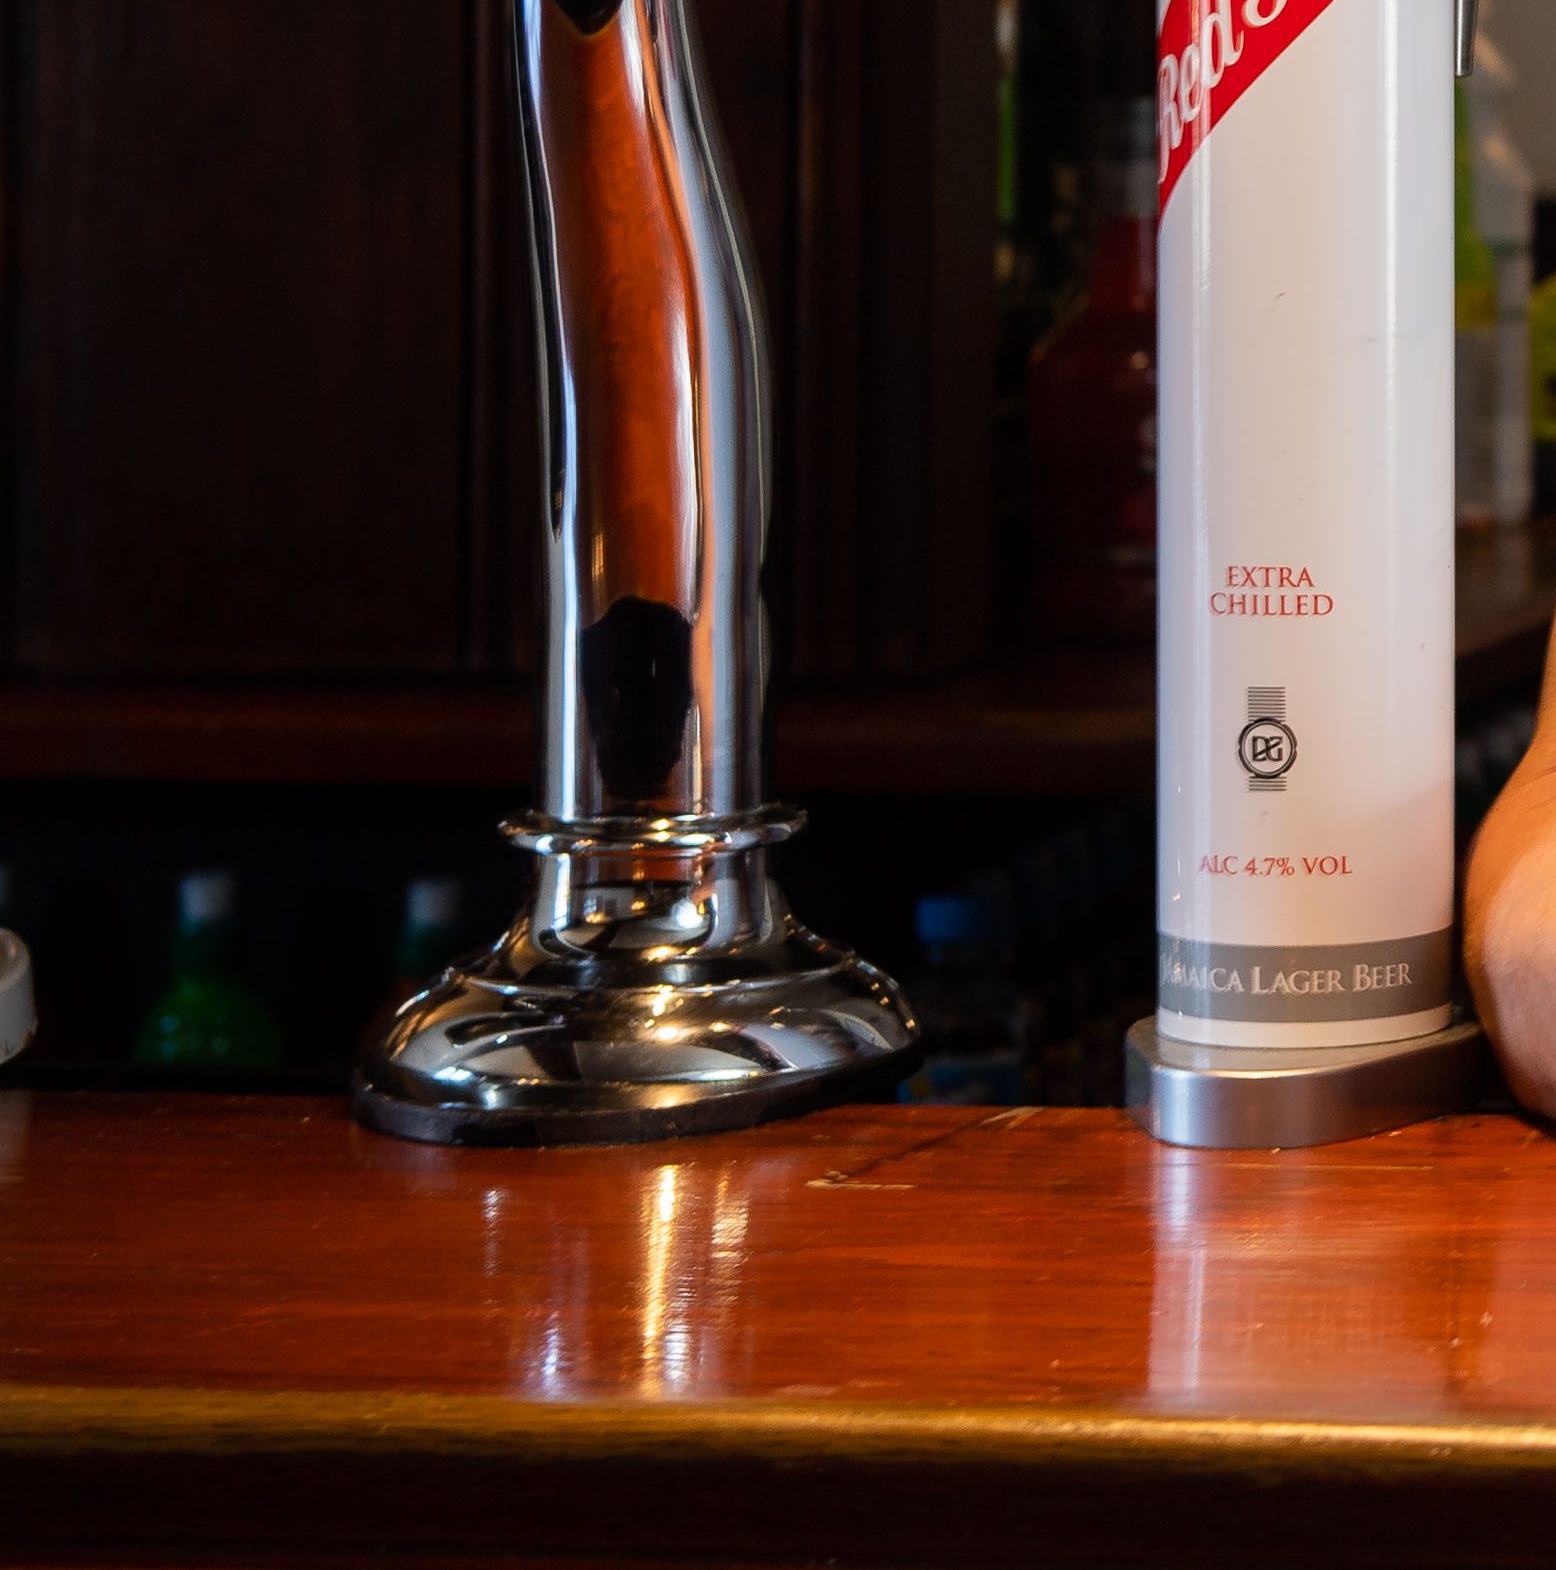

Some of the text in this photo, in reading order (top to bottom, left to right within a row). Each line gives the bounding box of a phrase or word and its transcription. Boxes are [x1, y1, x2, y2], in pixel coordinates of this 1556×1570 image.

[1225, 565, 1315, 589] EXTRA
[1208, 591, 1334, 617] CHILLED
[1197, 855, 1353, 878] ALC 4.7% VOL
[1250, 964, 1346, 996] LAGER
[1353, 961, 1413, 993] BEER
